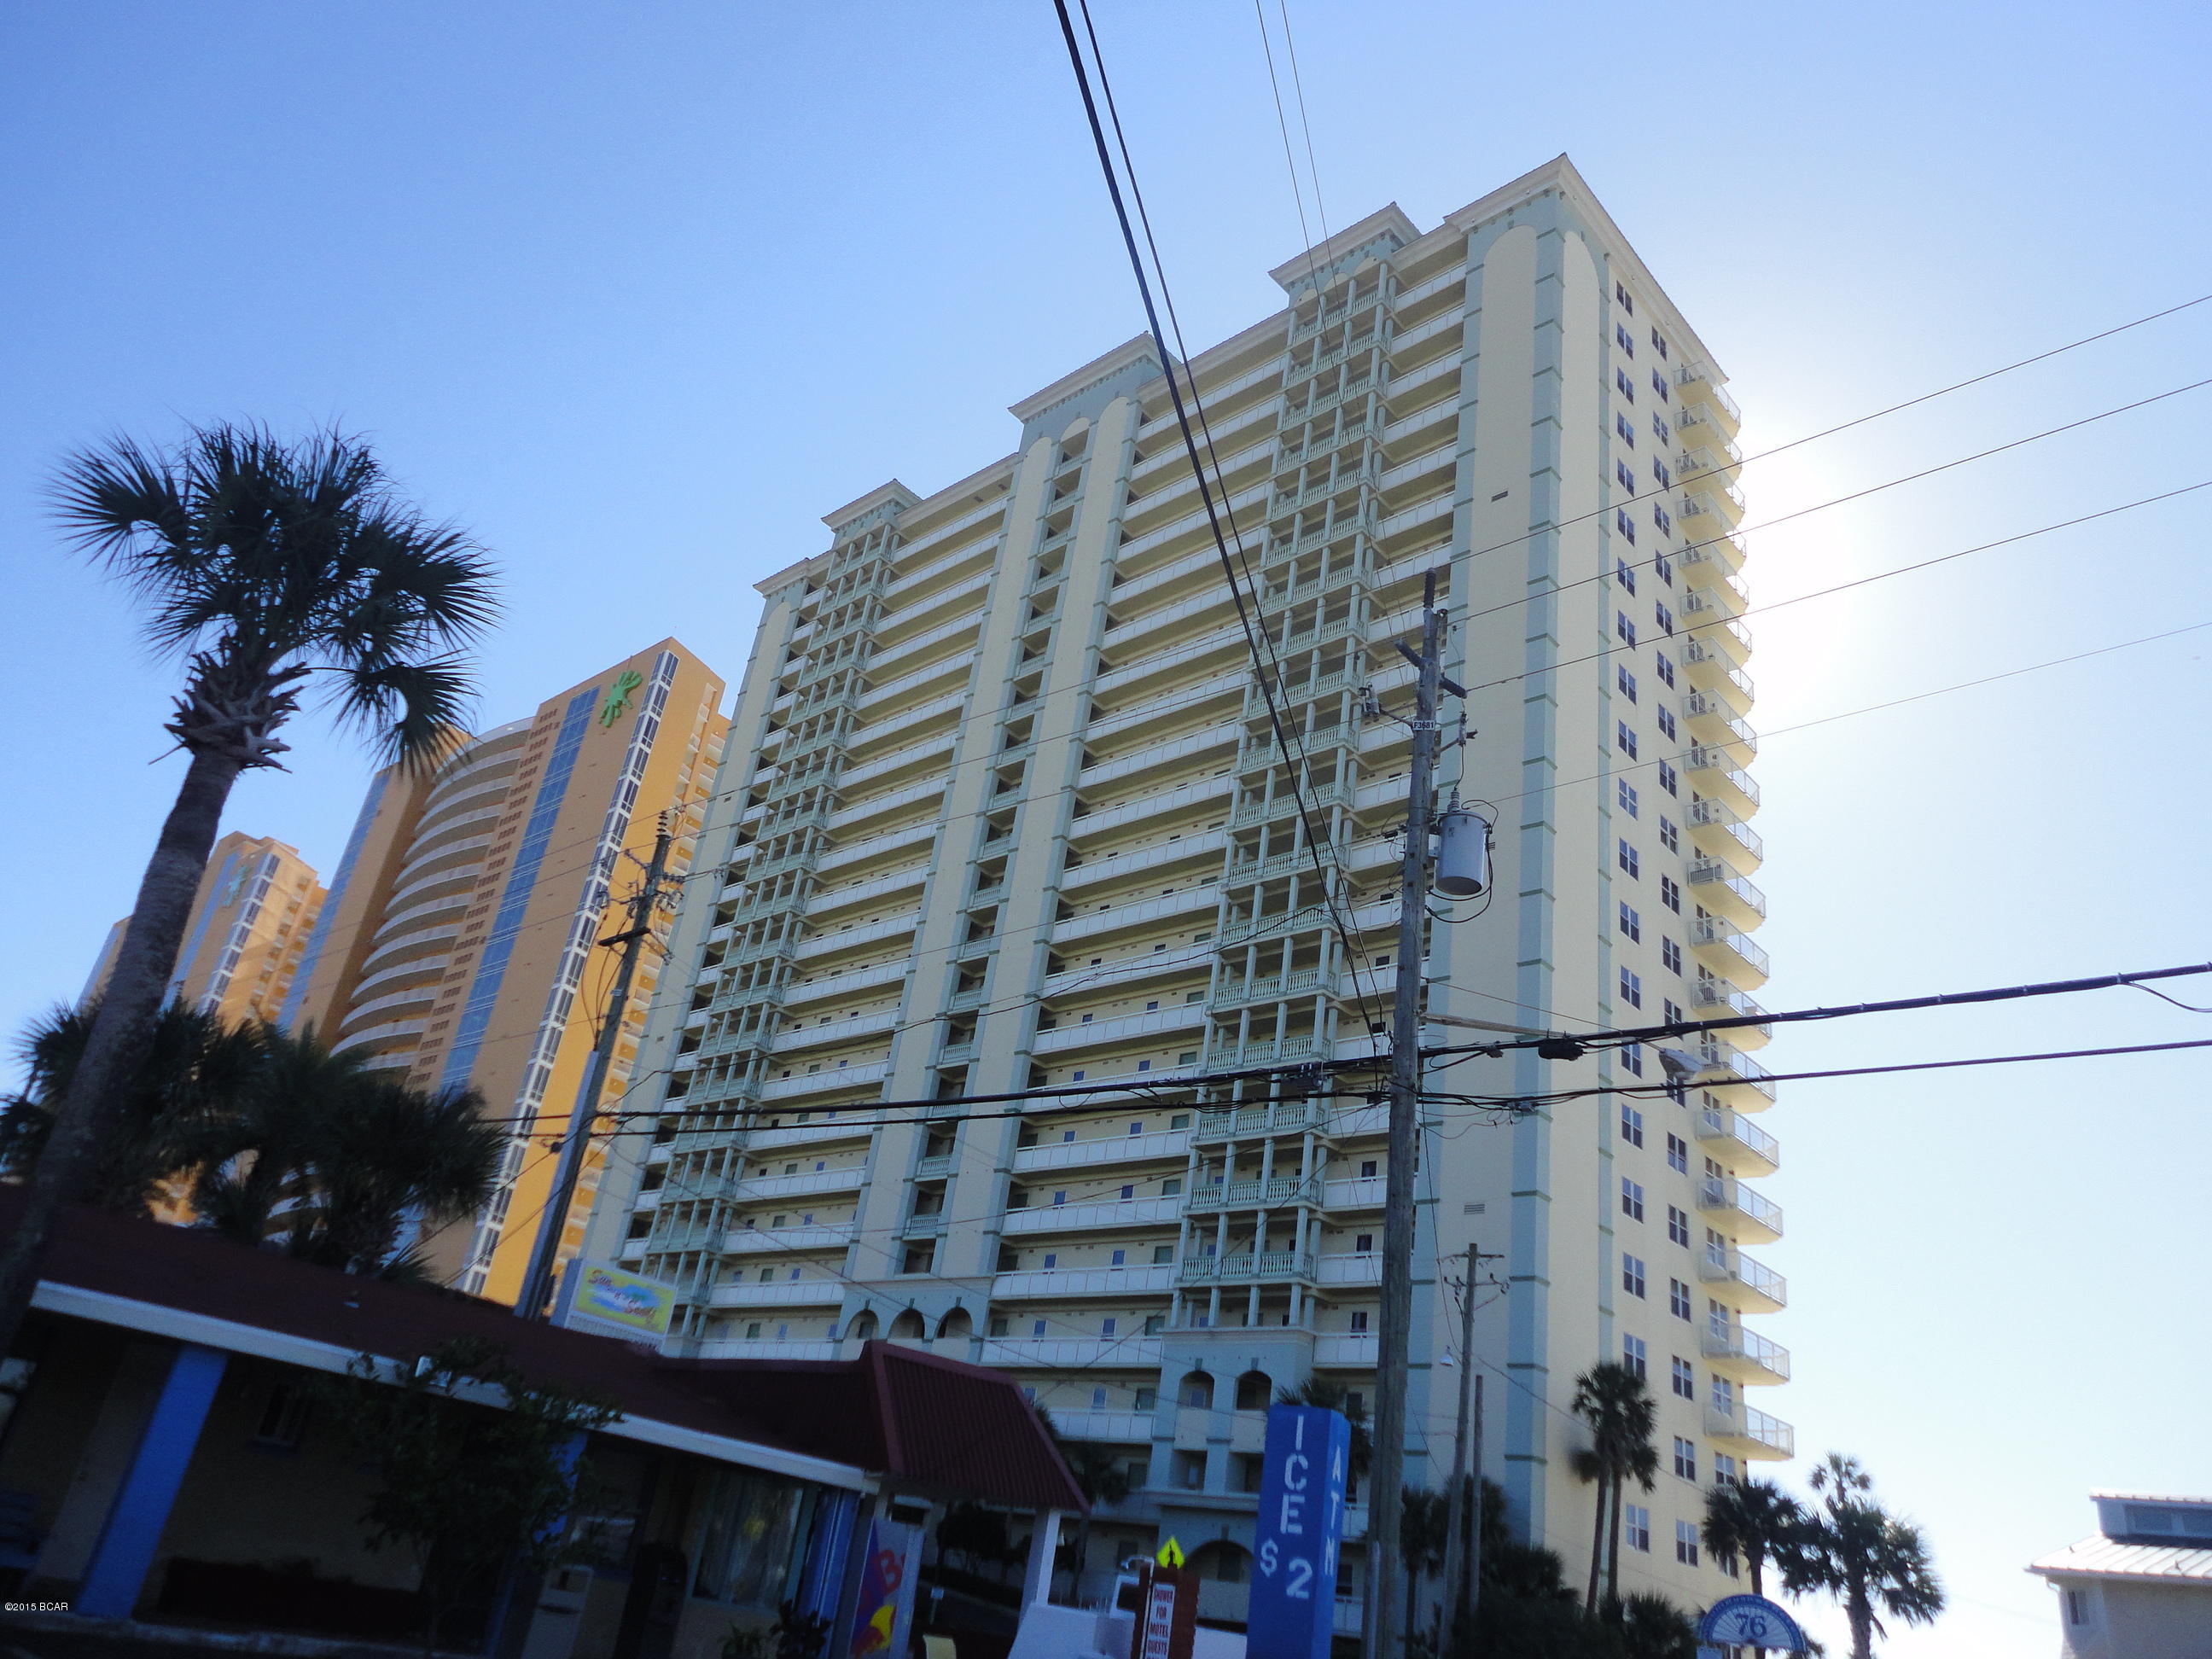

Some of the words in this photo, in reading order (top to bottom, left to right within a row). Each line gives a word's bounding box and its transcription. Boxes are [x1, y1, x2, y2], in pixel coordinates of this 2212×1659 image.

[1280, 1414, 1309, 1534] ICE
[1156, 1605, 1167, 1620] FOR
[1150, 1622, 1168, 1638] MOTEL
[1735, 1613, 1767, 1638] 76
[1147, 1640, 1167, 1655] GUESTS
